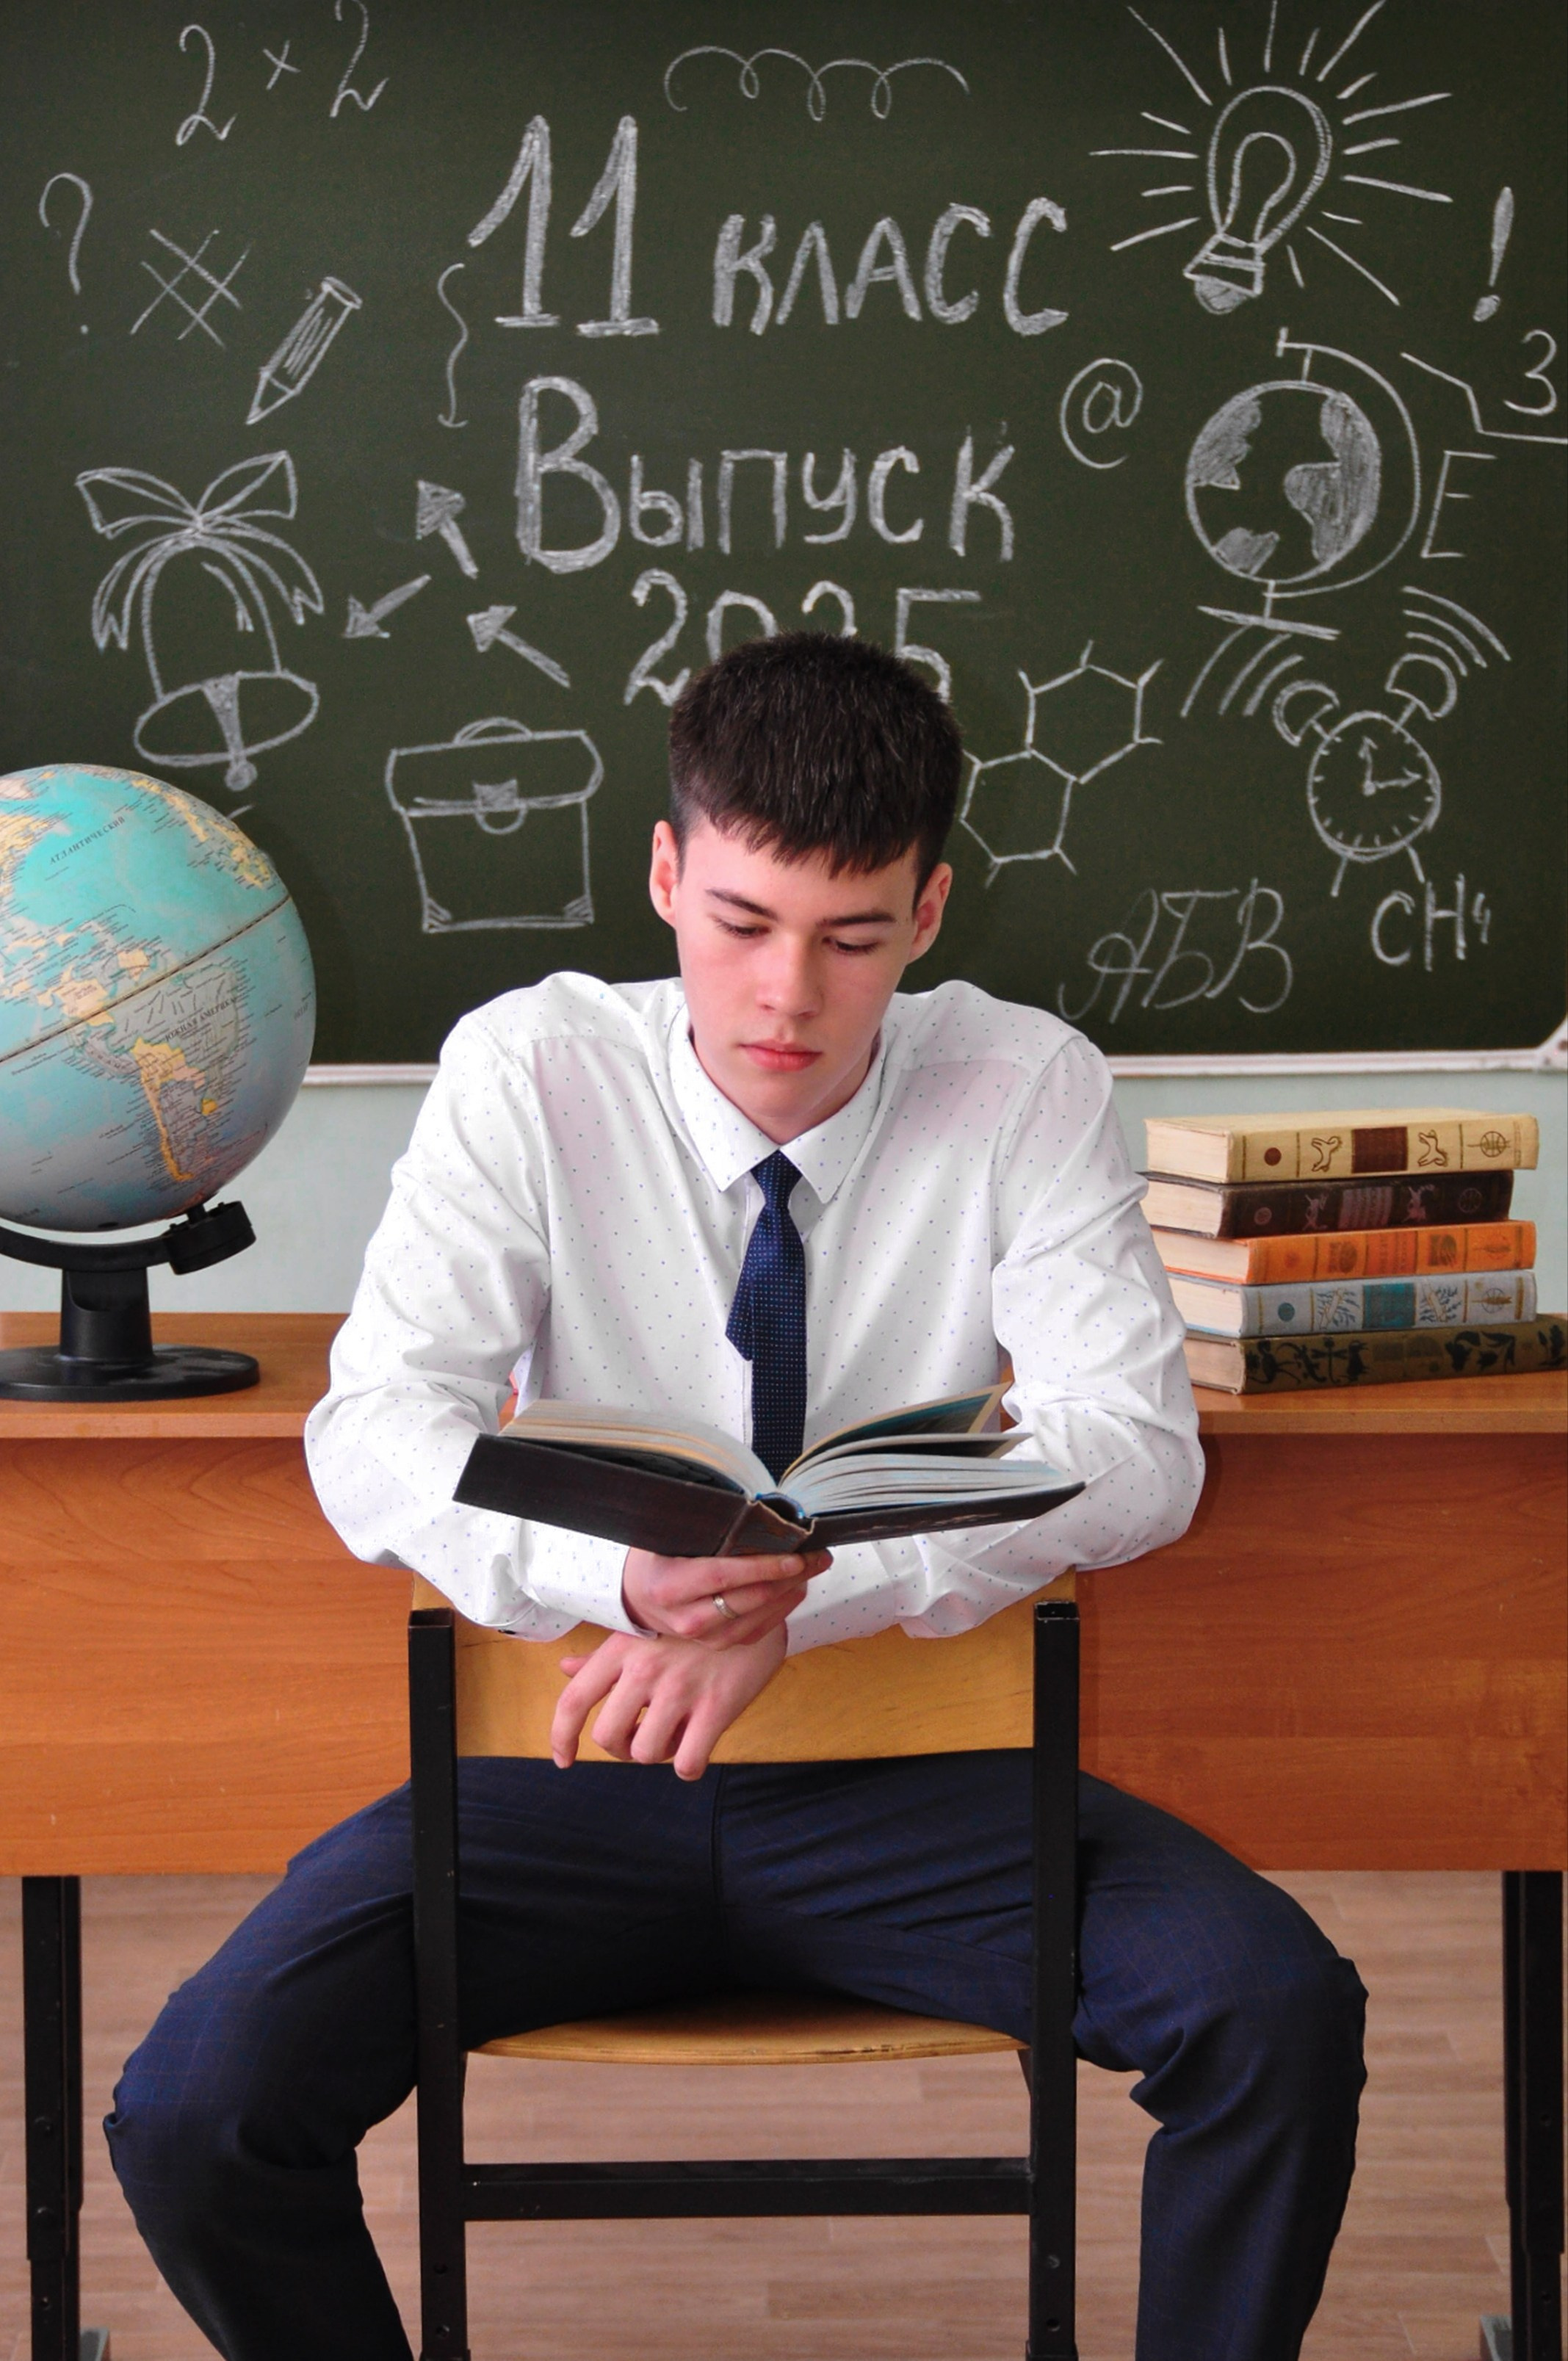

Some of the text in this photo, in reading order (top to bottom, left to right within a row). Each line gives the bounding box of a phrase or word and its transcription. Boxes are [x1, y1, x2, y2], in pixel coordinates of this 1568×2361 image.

[175, 24, 236, 146] 2
[329, 0, 389, 117] 2
[468, 115, 660, 337] 11
[1503, 329, 1558, 415] 3
[49, 816, 126, 865] АТЛАНТИЧЕСКИЙ
